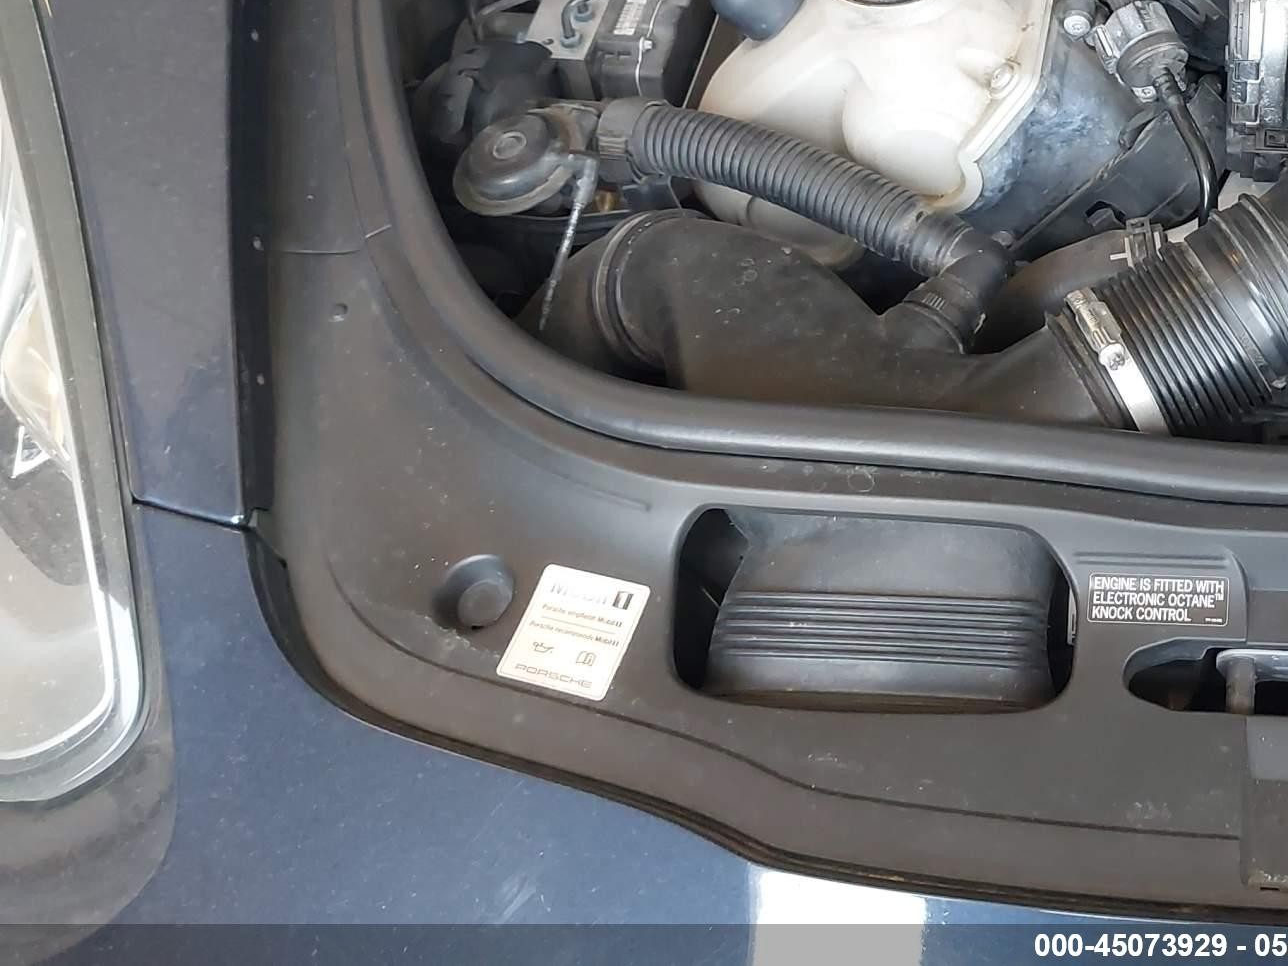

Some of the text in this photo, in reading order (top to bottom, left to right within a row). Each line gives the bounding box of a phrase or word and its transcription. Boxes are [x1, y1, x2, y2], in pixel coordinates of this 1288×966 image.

[1094, 576, 1224, 594] ENGINE IS FITTED WITH
[1093, 591, 1165, 606] ELECTRONIC
[1092, 606, 1133, 620] KNOCK
[1136, 608, 1192, 622] CONTROL
[515, 663, 592, 688] PORSCHE
